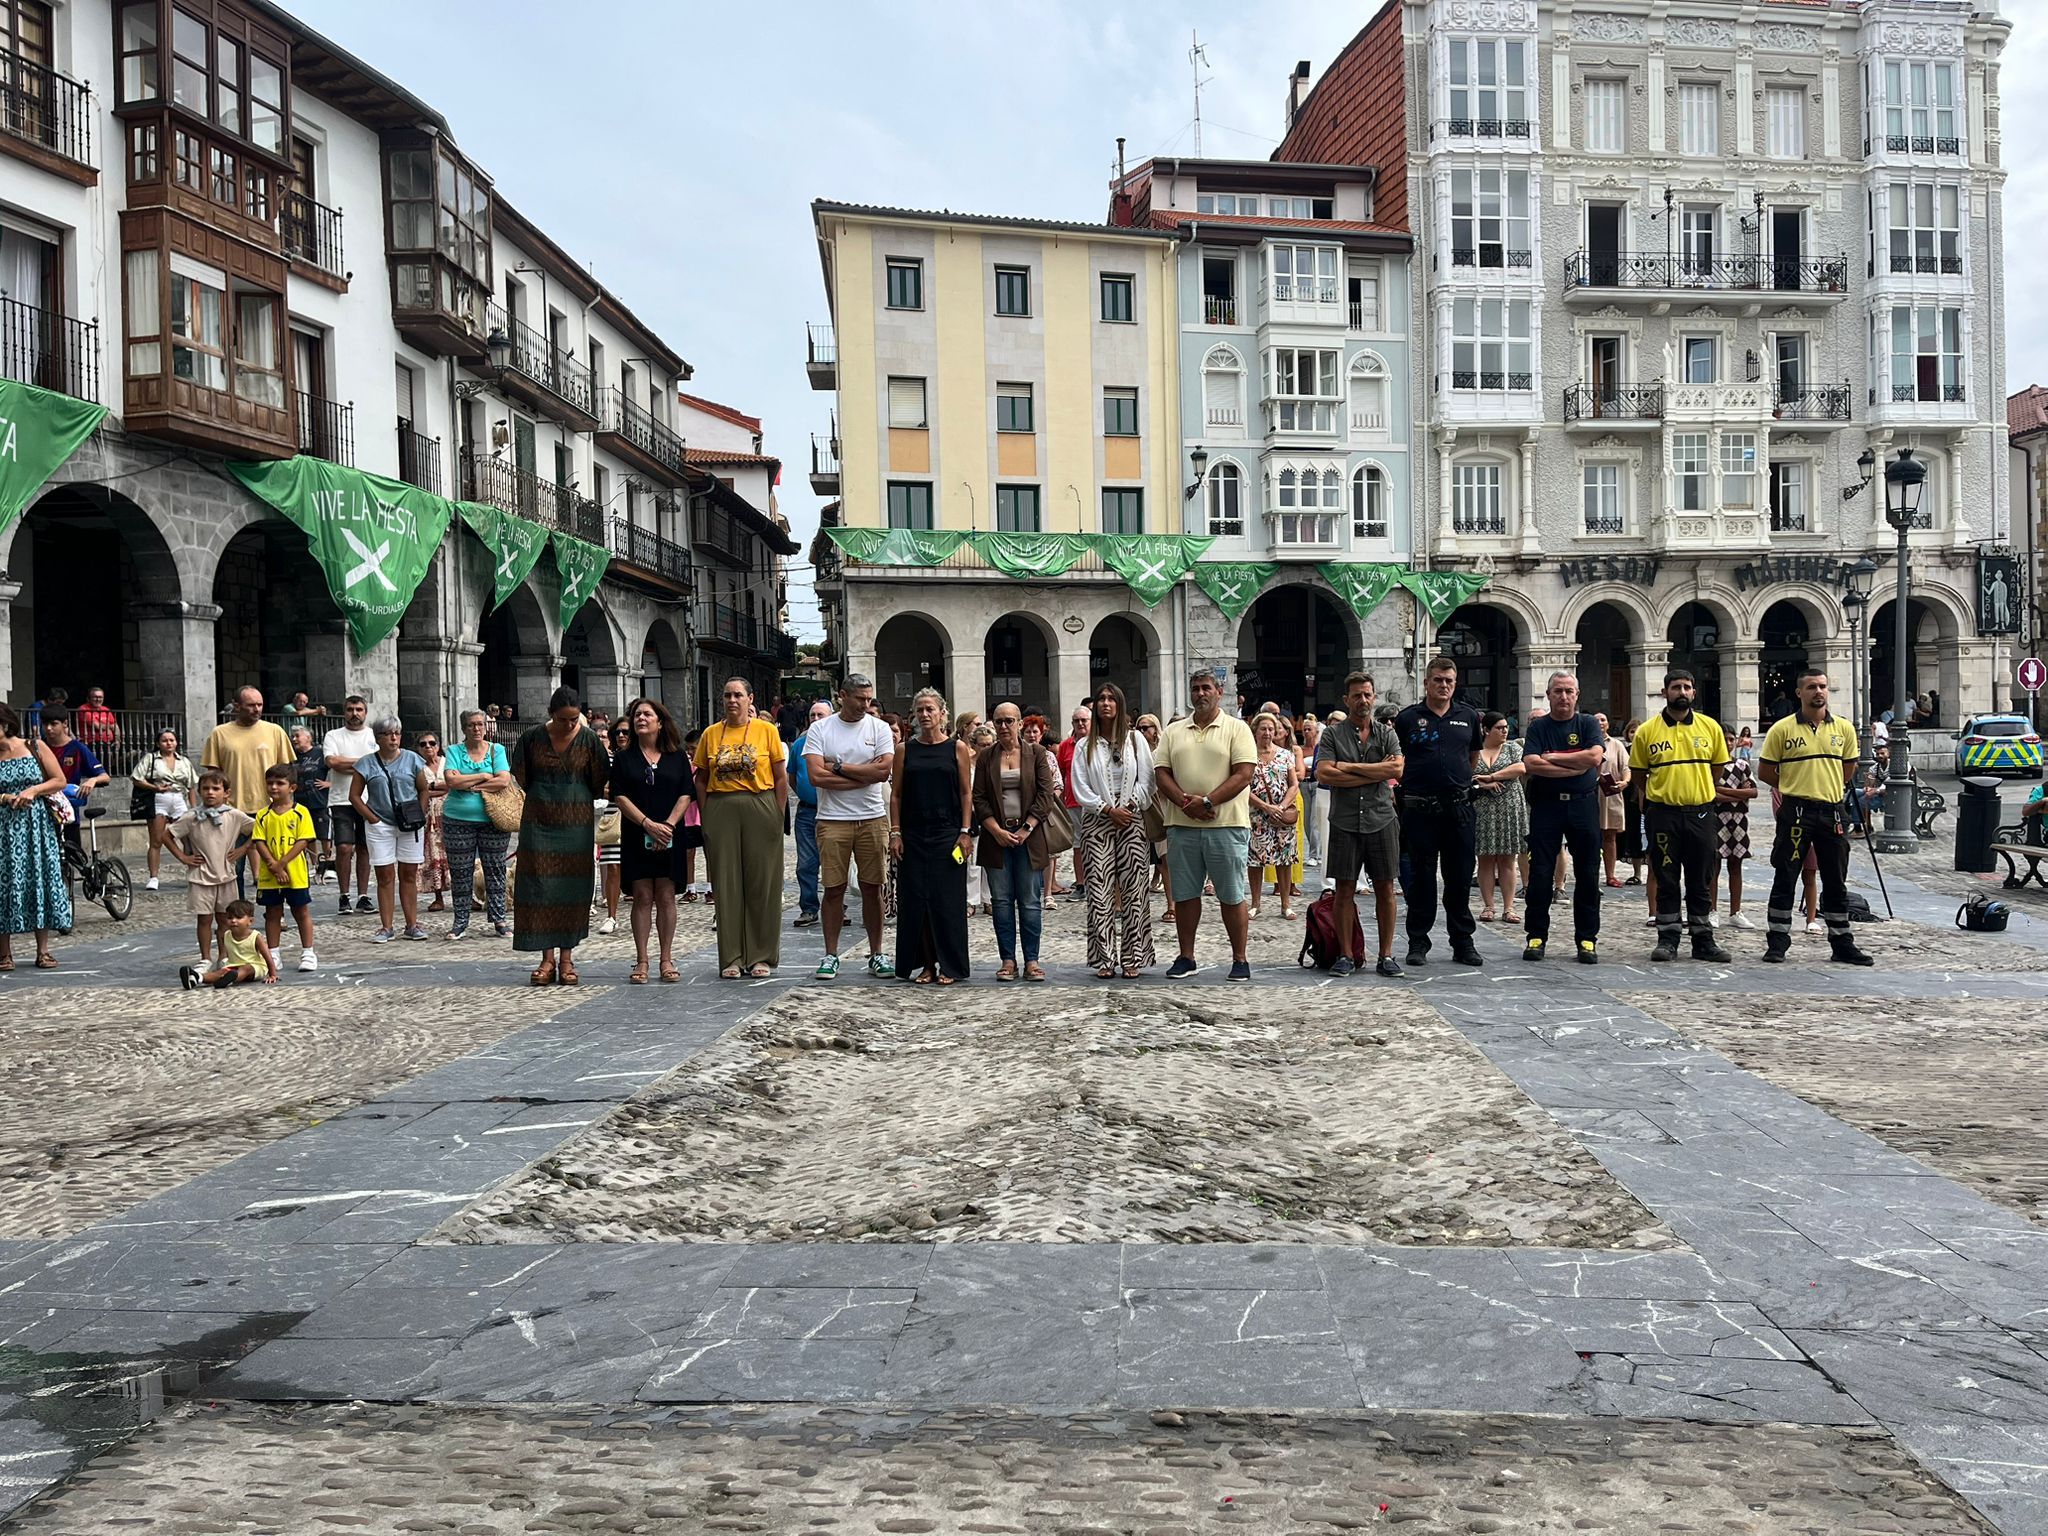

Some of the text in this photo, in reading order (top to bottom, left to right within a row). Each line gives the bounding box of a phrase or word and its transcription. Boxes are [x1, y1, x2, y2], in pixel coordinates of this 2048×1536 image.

[311, 489, 418, 545] VIVE LA FIESTA
[1020, 542, 1032, 555] LA
[1139, 541, 1152, 555] LA
[1154, 542, 1182, 558] FIESTA
[1223, 570, 1233, 580] LA
[1234, 570, 1256, 583] FIESTA
[1355, 570, 1365, 581] LA
[1559, 554, 1855, 592] MESON MARINER
[1649, 740, 1673, 755] DYA
[1784, 736, 1807, 750] DYA
[1656, 832, 1673, 867] DYA
[1791, 826, 1803, 862] DYA
